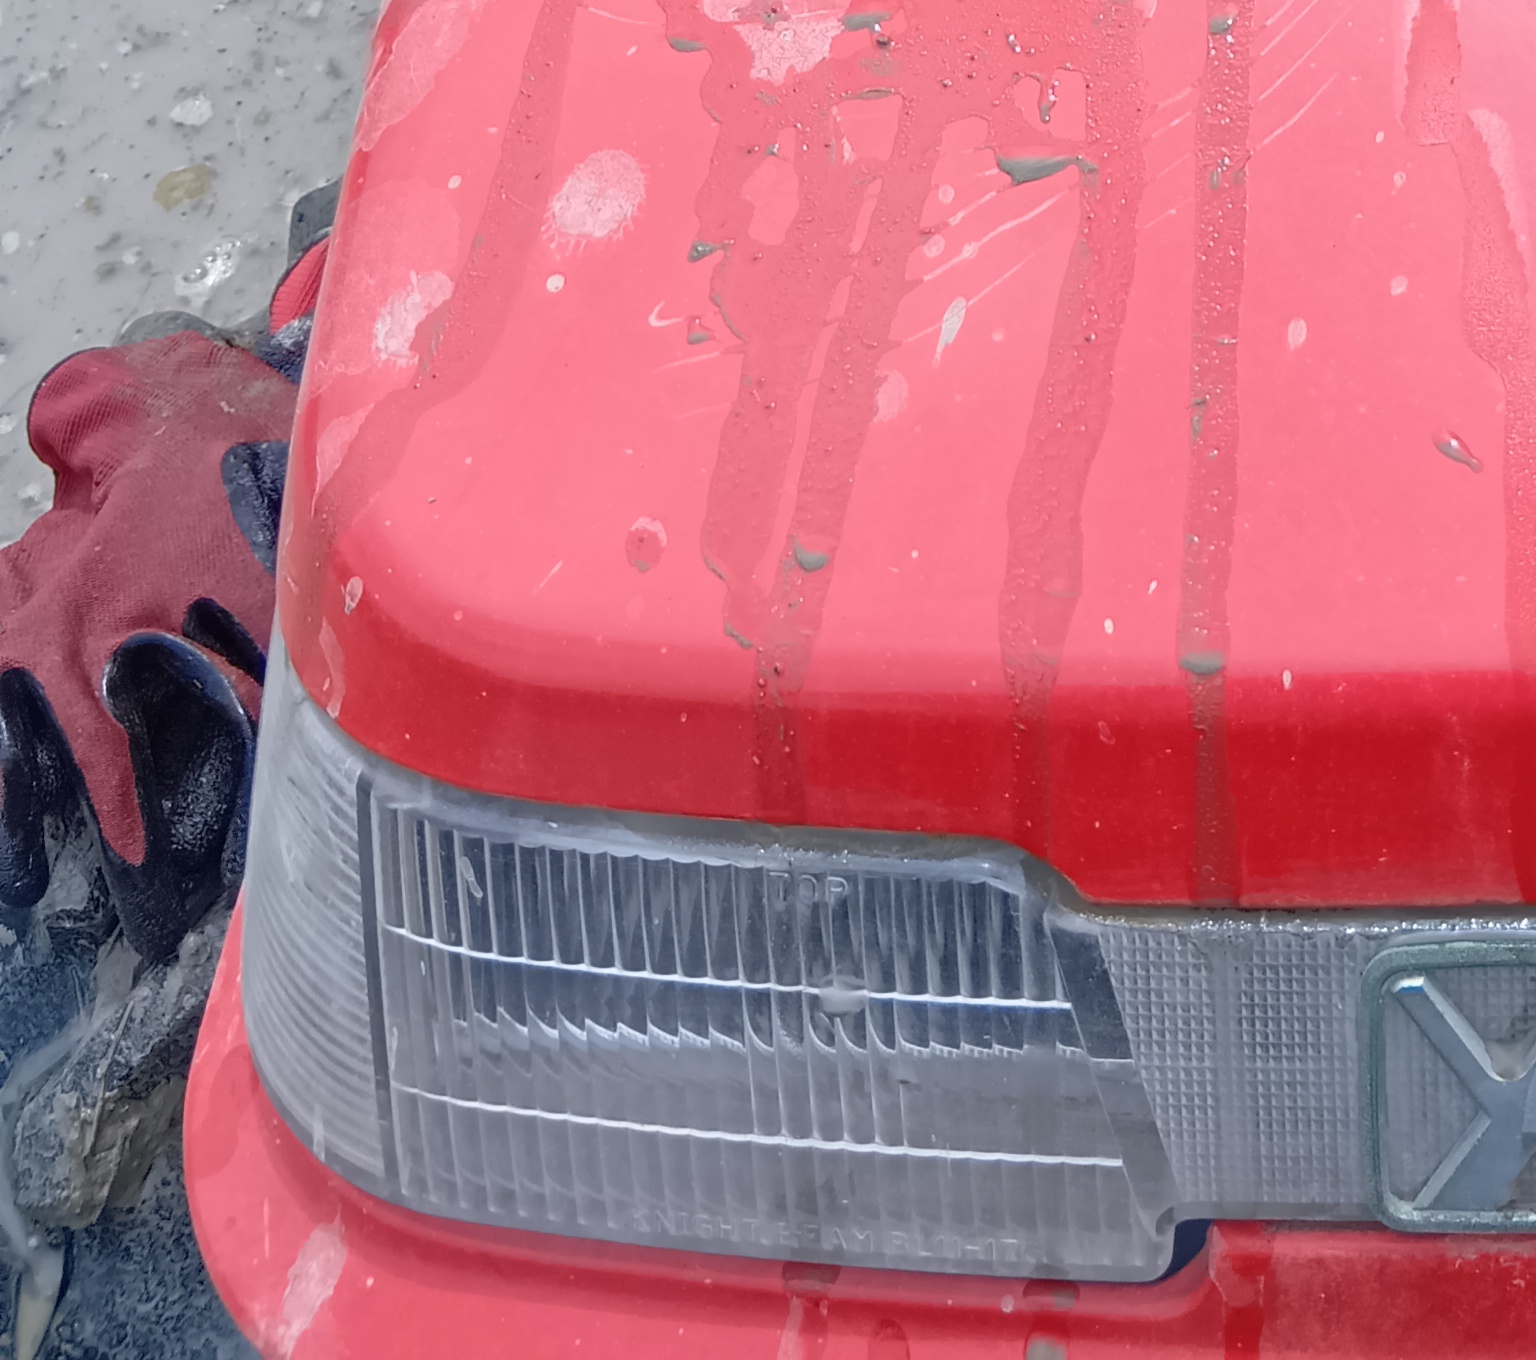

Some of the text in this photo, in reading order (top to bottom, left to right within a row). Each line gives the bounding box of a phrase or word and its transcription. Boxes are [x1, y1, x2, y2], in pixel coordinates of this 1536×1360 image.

[768, 871, 849, 903] TOP
[633, 1208, 759, 1243] KNIGHT
[778, 1221, 873, 1253] BEAM
